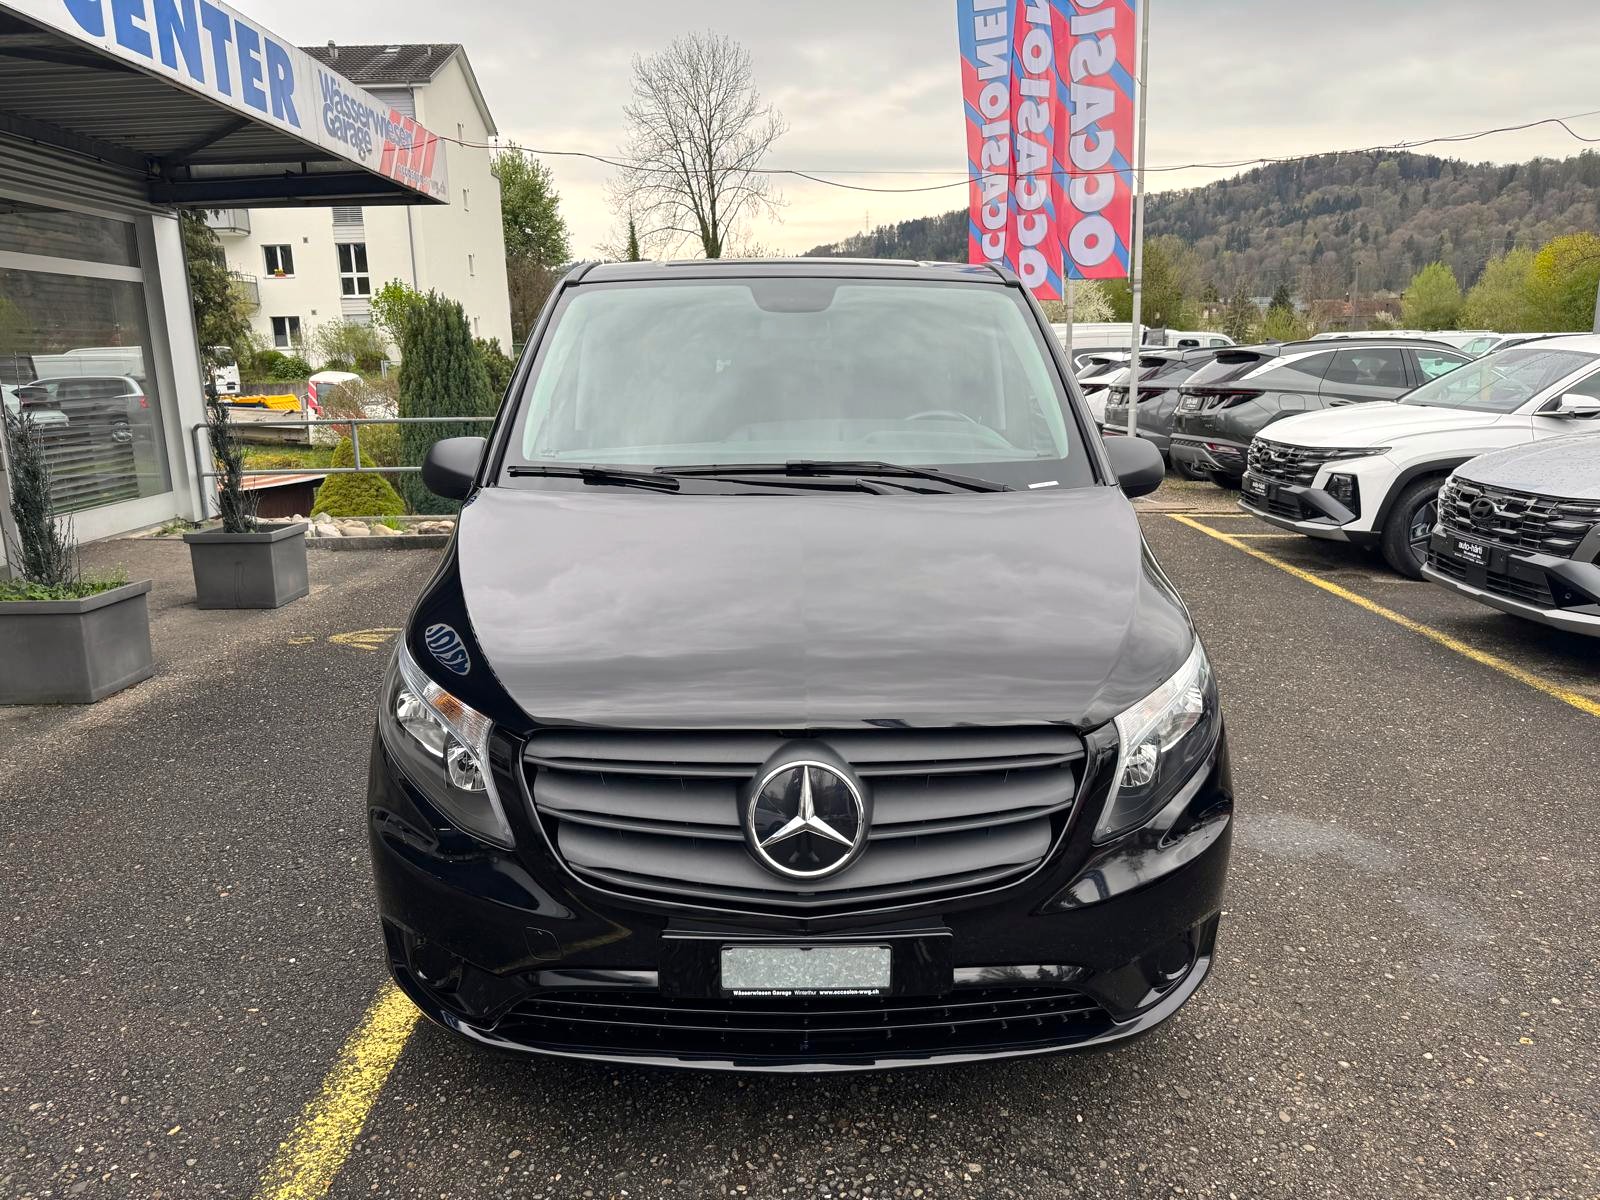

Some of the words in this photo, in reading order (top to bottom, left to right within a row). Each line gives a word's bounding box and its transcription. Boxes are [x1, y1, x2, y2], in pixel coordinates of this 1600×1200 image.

[63, 0, 302, 129] ENTER
[318, 69, 412, 150] Wässerwiesen
[323, 102, 373, 161] Garage
